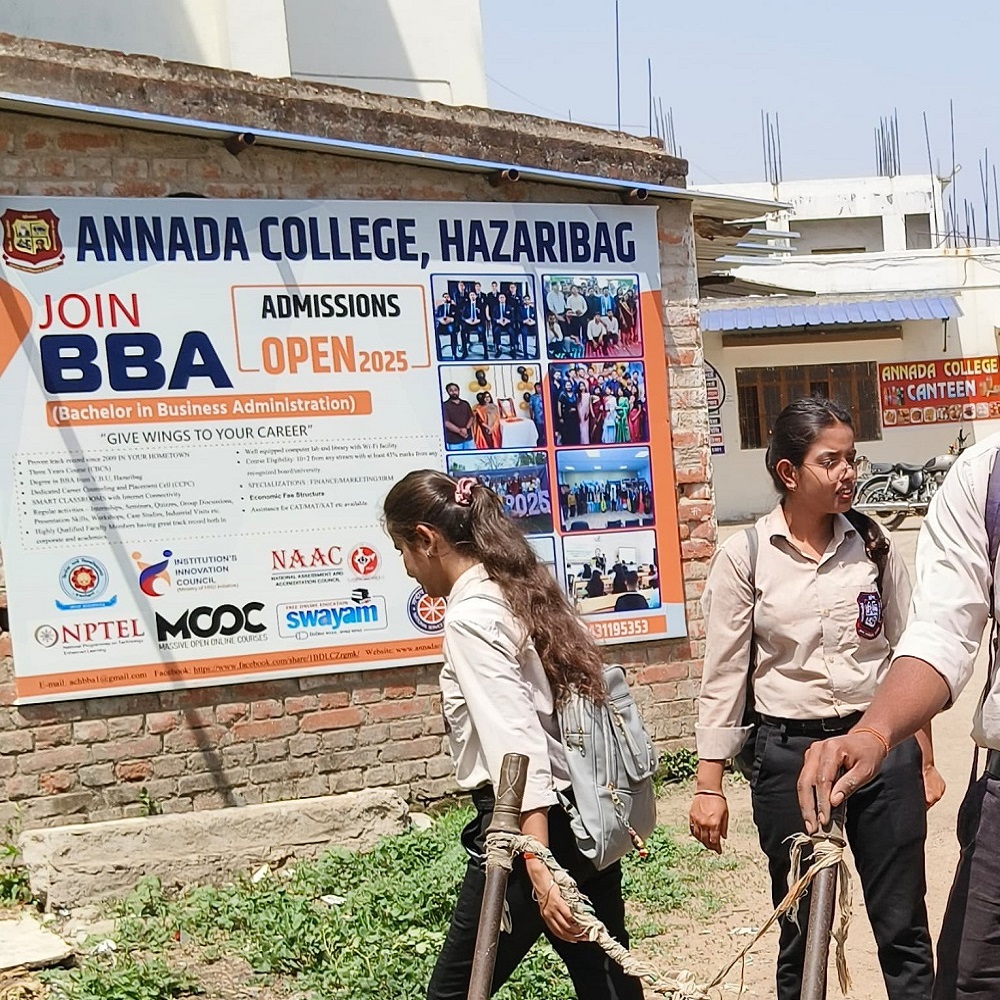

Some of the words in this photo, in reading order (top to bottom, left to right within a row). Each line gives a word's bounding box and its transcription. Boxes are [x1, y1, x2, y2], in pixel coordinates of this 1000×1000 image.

[76, 215, 250, 262] ANNADA
[259, 216, 430, 269] COLLEGE,
[439, 219, 636, 264] HAZARIBAG
[38, 293, 140, 330] JOIN
[261, 293, 401, 320] ADMISSIONS
[39, 330, 234, 395] BBA
[261, 336, 357, 375] OPEN
[359, 349, 409, 373] 2025
[881, 363, 936, 382] ANNADA
[943, 358, 999, 377] COLLEGE
[907, 380, 977, 401] CANTEEN
[52, 402, 132, 424] (Bachelor
[136, 401, 153, 418] in
[157, 400, 228, 418] Business
[232, 395, 357, 415] Administration)
[142, 429, 192, 444] WINGS
[194, 428, 213, 442] TO
[215, 426, 255, 441] YOUR
[175, 565, 229, 576] INNOVATION
[271, 545, 343, 571] NAAC
[176, 577, 217, 587] COUNCIL
[155, 601, 267, 642] MOOC
[286, 604, 379, 630] swayam
[61, 618, 145, 644] NPTEL
[158, 640, 189, 651] MASSIVE
[190, 638, 210, 648] OPEN
[210, 636, 237, 646] ONLINE
[237, 634, 268, 644] COURSES
